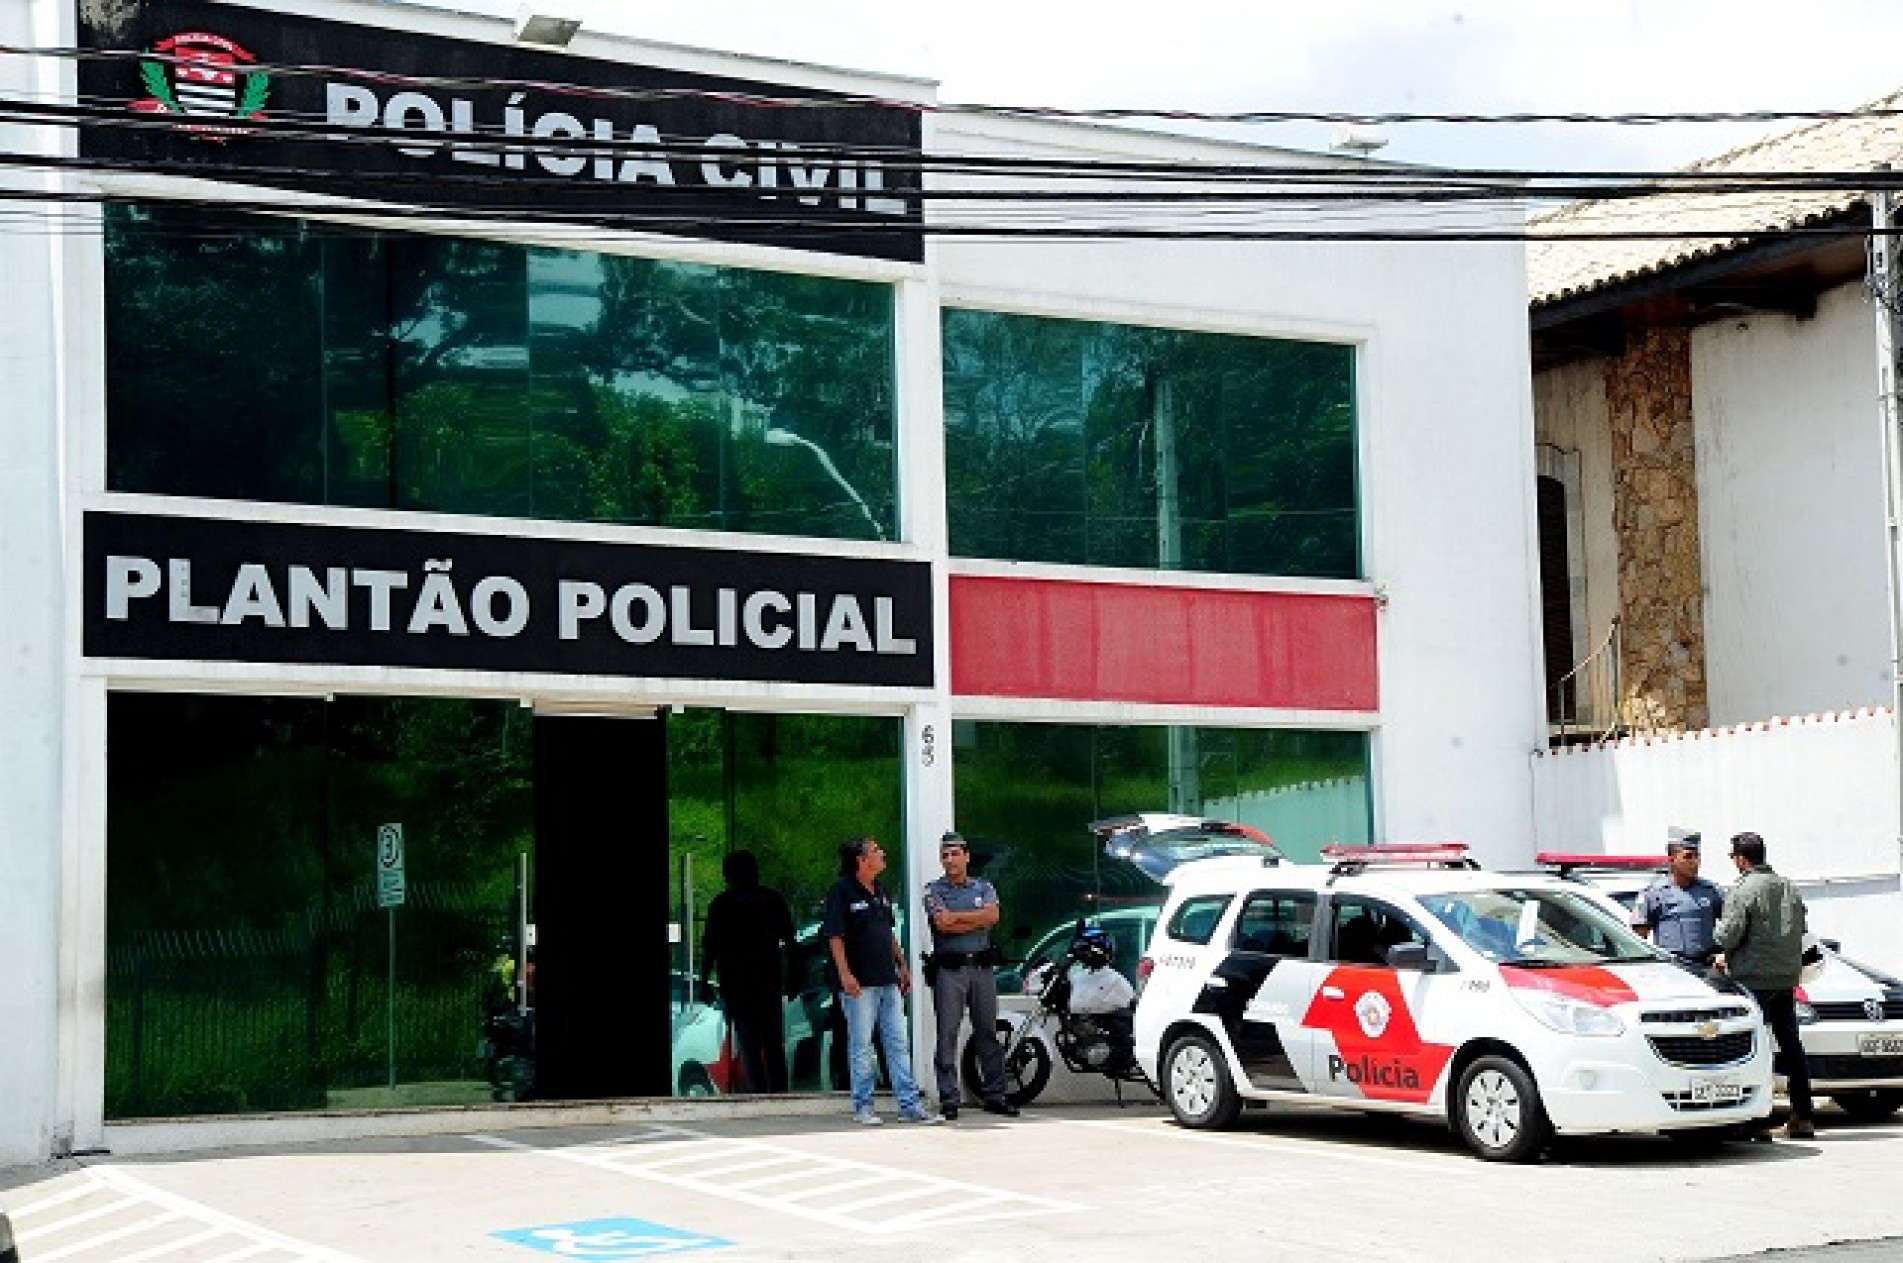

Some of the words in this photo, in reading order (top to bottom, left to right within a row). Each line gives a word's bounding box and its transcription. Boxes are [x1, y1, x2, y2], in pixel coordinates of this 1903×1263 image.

[326, 82, 675, 186] POLÍCIA
[700, 133, 908, 215] CIVIL
[107, 556, 529, 637] PLANTÃO
[559, 580, 917, 654] POLICIAL
